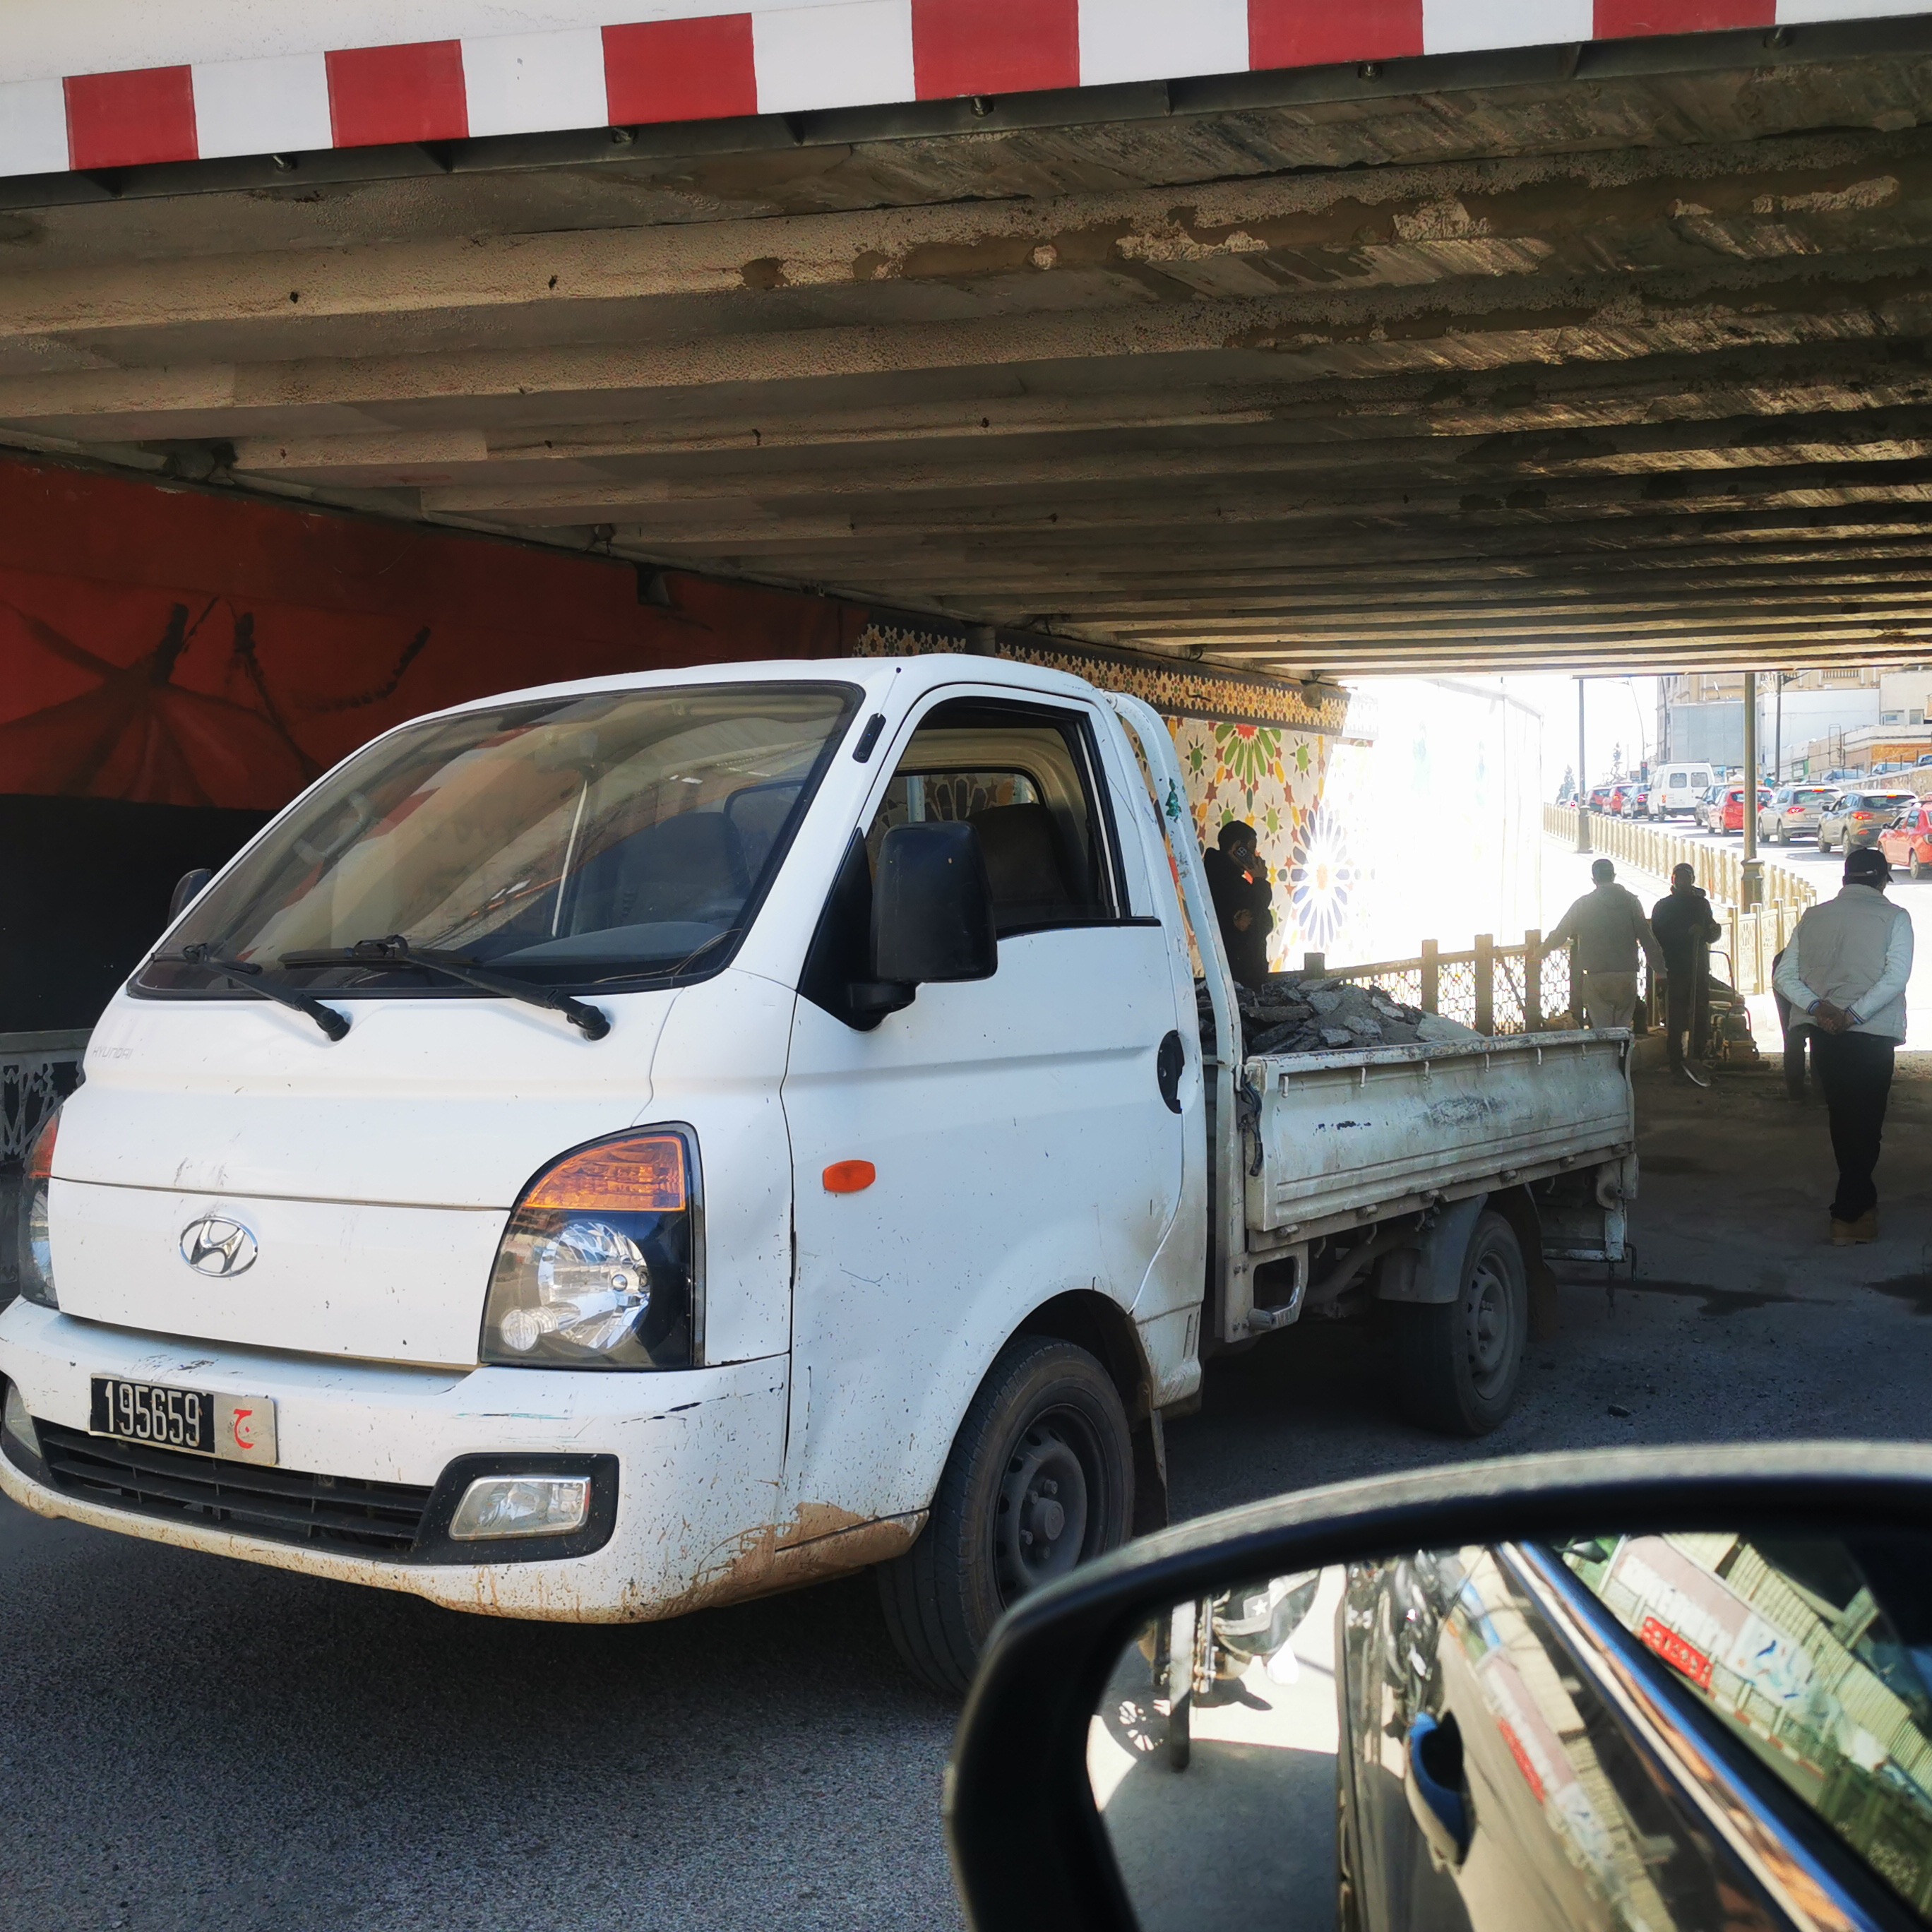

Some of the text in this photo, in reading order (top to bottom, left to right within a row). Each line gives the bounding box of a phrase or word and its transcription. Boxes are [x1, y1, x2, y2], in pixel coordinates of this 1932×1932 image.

[92, 1045, 134, 1060] HYUNDAI
[105, 1381, 255, 1450] 195659 ج
